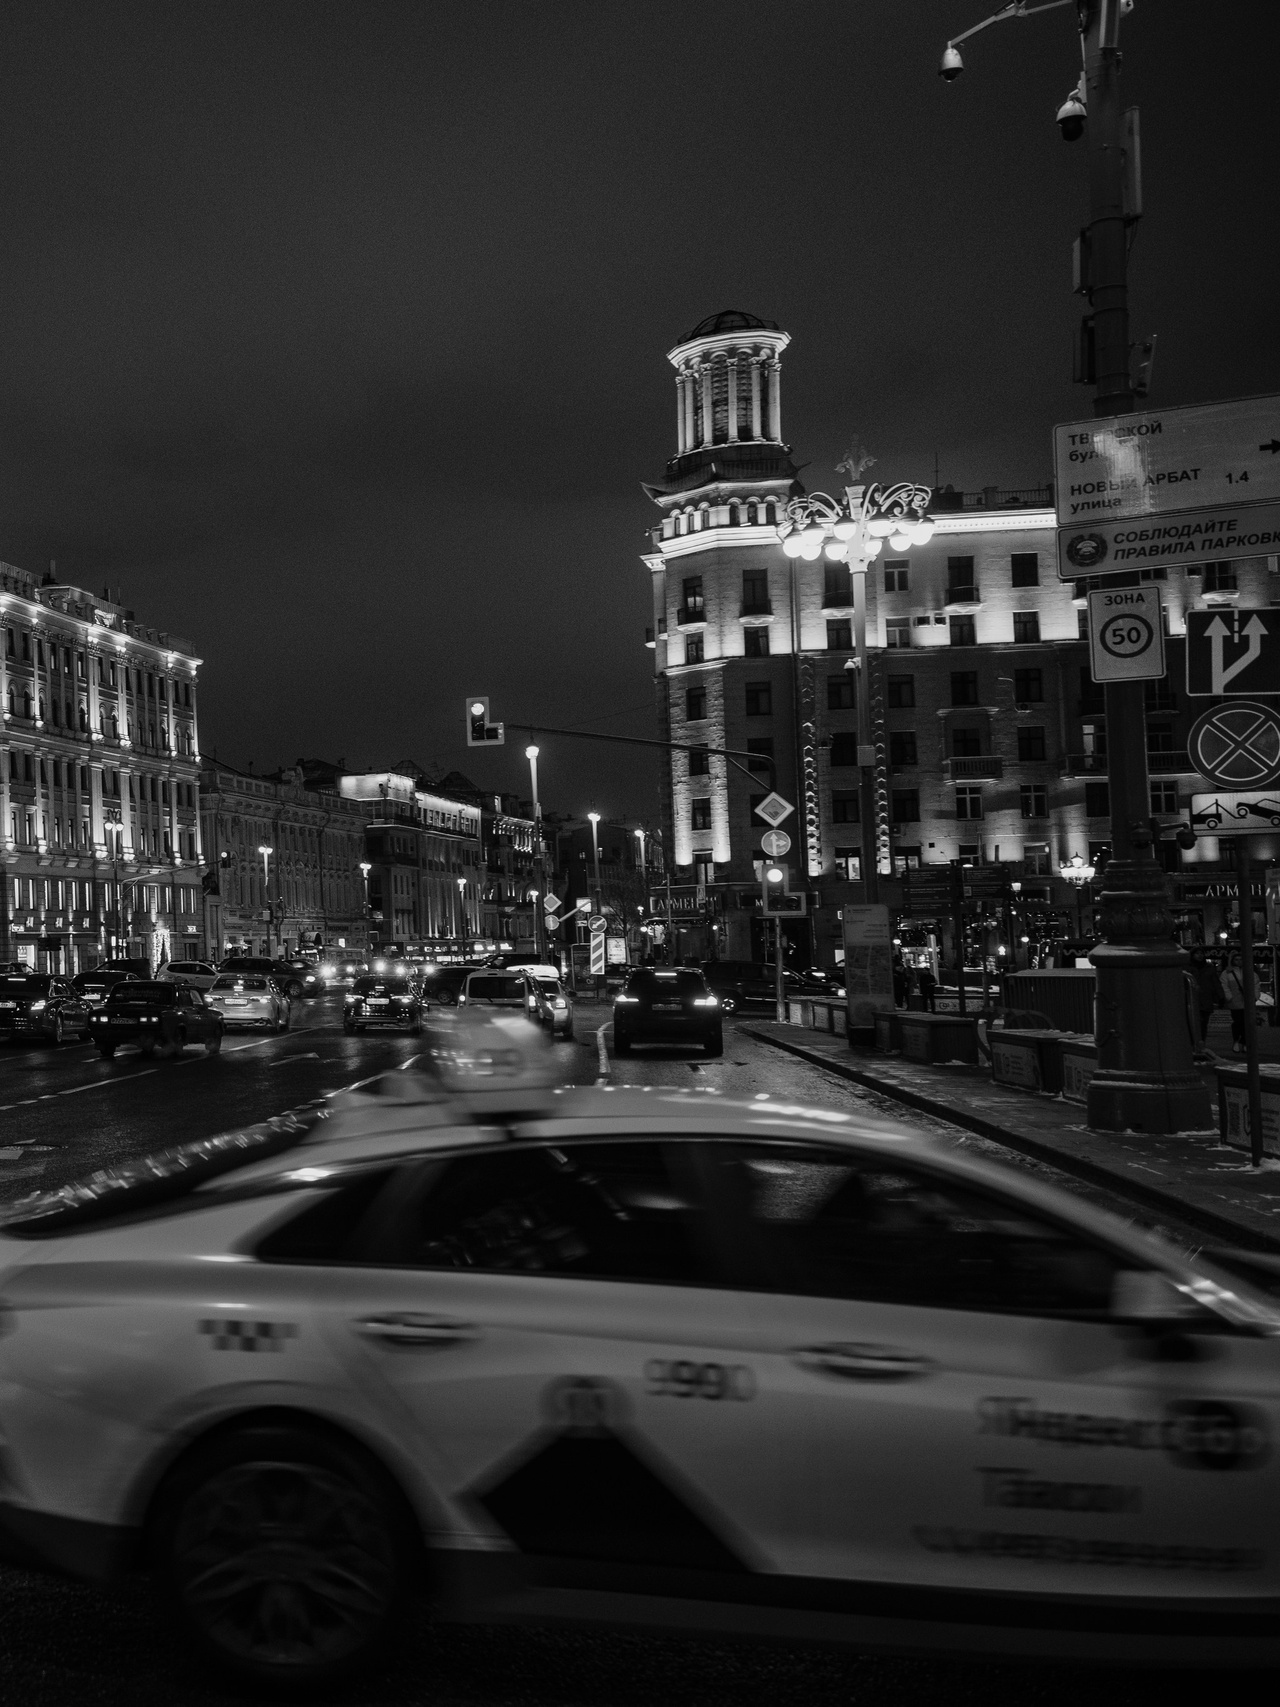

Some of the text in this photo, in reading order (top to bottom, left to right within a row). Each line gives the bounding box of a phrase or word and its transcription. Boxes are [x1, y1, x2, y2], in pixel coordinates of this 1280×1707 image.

[1068, 420, 1162, 446] ТВСКОЙ
[1142, 468, 1201, 487] АРБАТ
[1225, 470, 1249, 485] 1.4
[1070, 497, 1122, 514] улица
[1113, 518, 1238, 544] СОБЛЮДАЙТЕ
[1113, 540, 1195, 561] ПРАВИЛА
[1104, 592, 1145, 606] ЗОНА
[1112, 626, 1141, 646] 50
